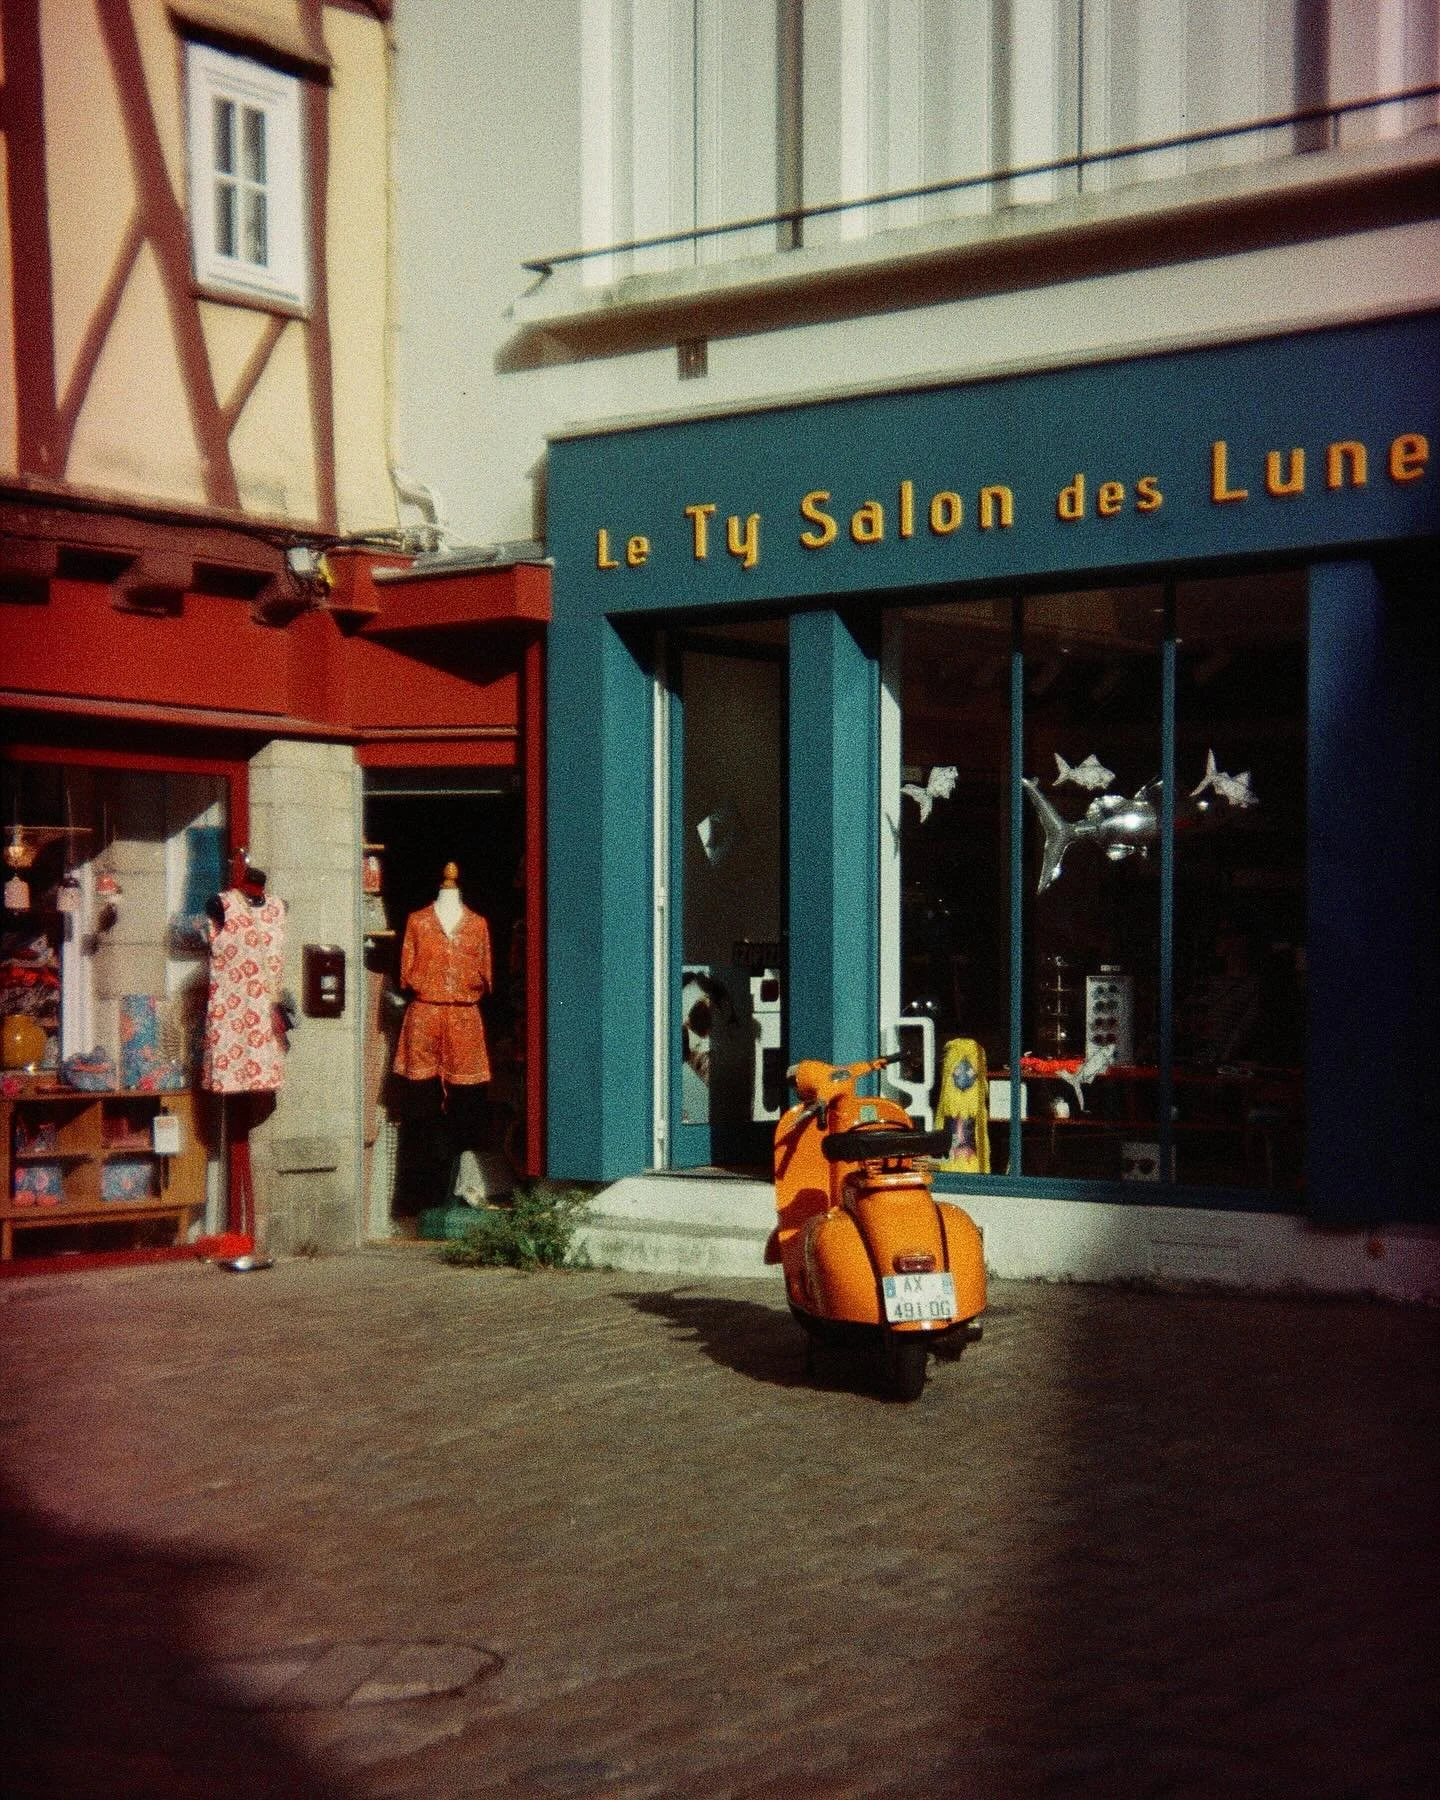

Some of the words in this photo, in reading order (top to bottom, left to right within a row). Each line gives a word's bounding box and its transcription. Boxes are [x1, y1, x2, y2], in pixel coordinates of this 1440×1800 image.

[597, 529, 649, 568] Le
[685, 503, 760, 568] Ty
[800, 480, 1014, 548] Salon
[1057, 473, 1163, 521] des
[1211, 432, 1430, 502] Lune
[903, 1275, 923, 1293] AX
